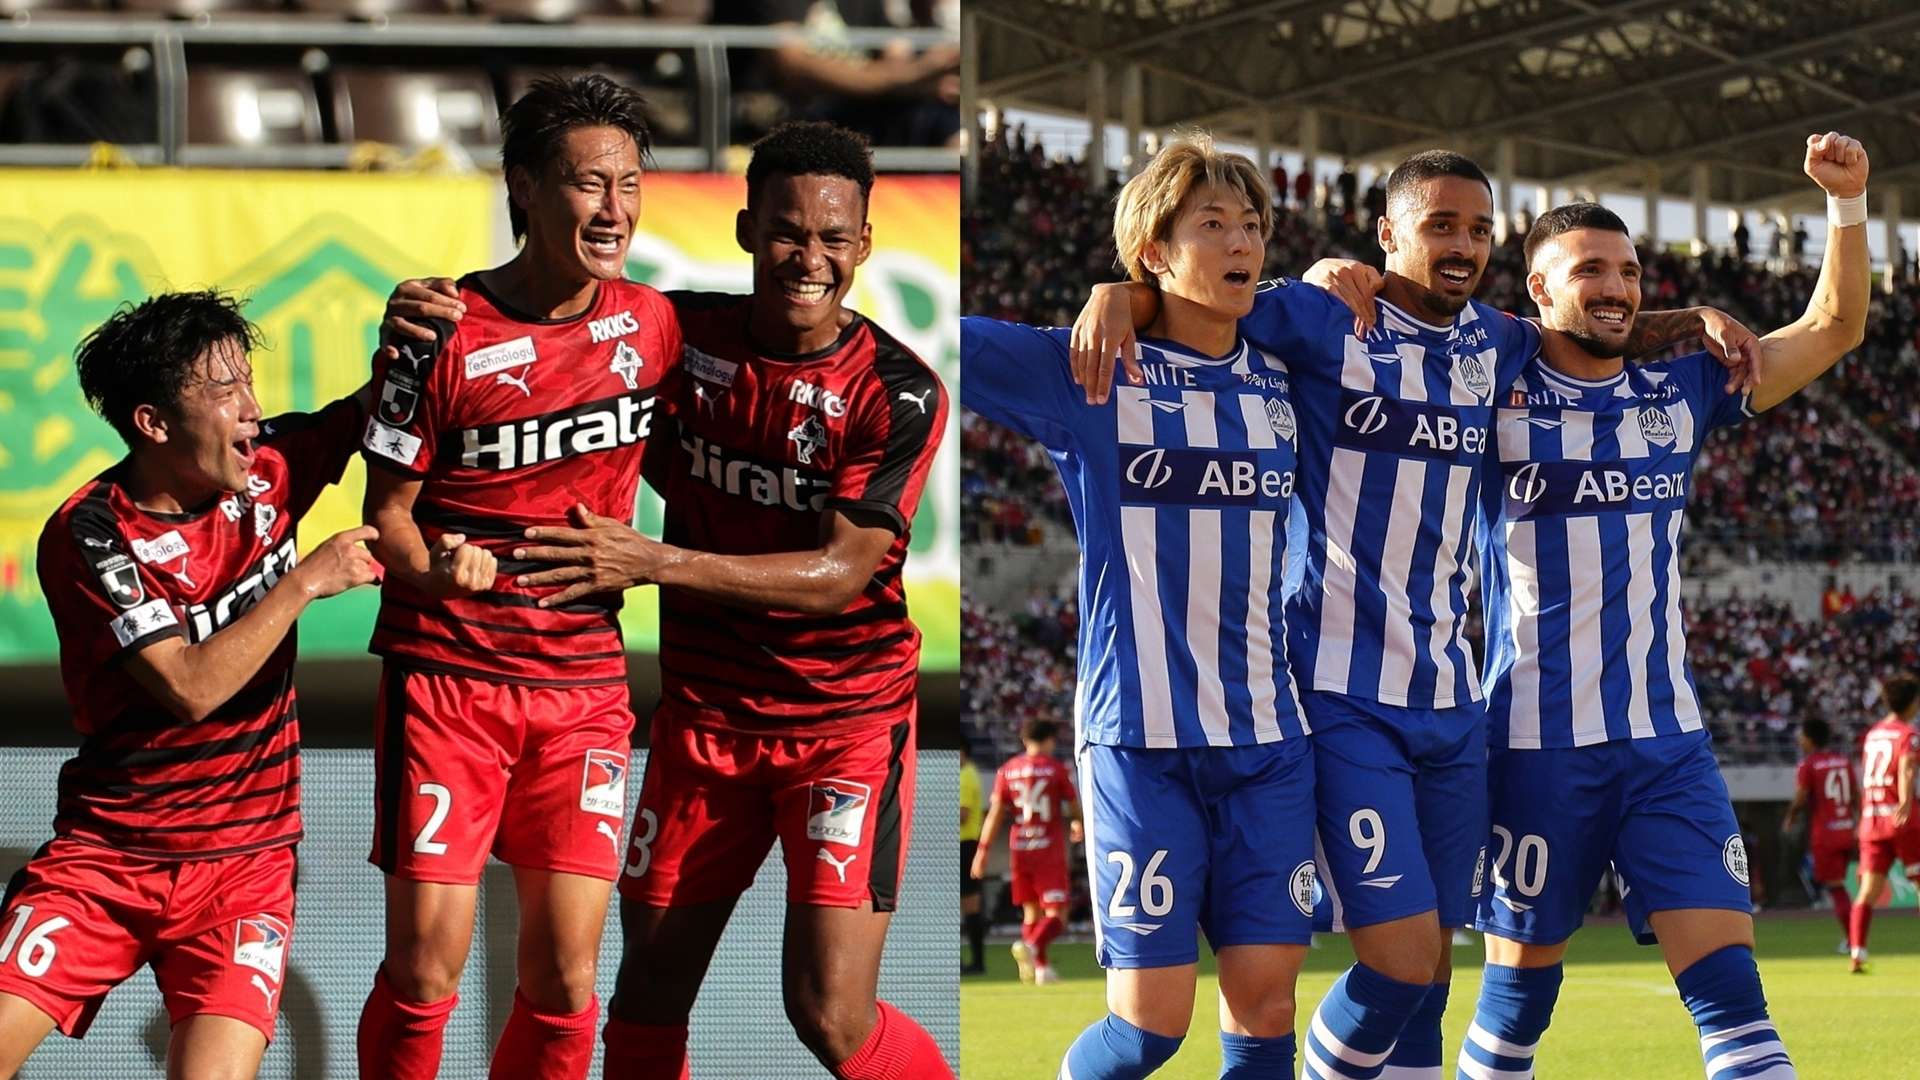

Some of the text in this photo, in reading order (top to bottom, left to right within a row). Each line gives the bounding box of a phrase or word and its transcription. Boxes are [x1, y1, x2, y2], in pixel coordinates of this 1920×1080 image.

[587, 310, 640, 344] RKKCS
[414, 783, 451, 855] 2
[1008, 778, 1051, 823] 34
[1349, 808, 1386, 874] 9
[1490, 824, 1549, 897] 20
[1107, 850, 1174, 917] 26
[0, 905, 72, 978] 16
